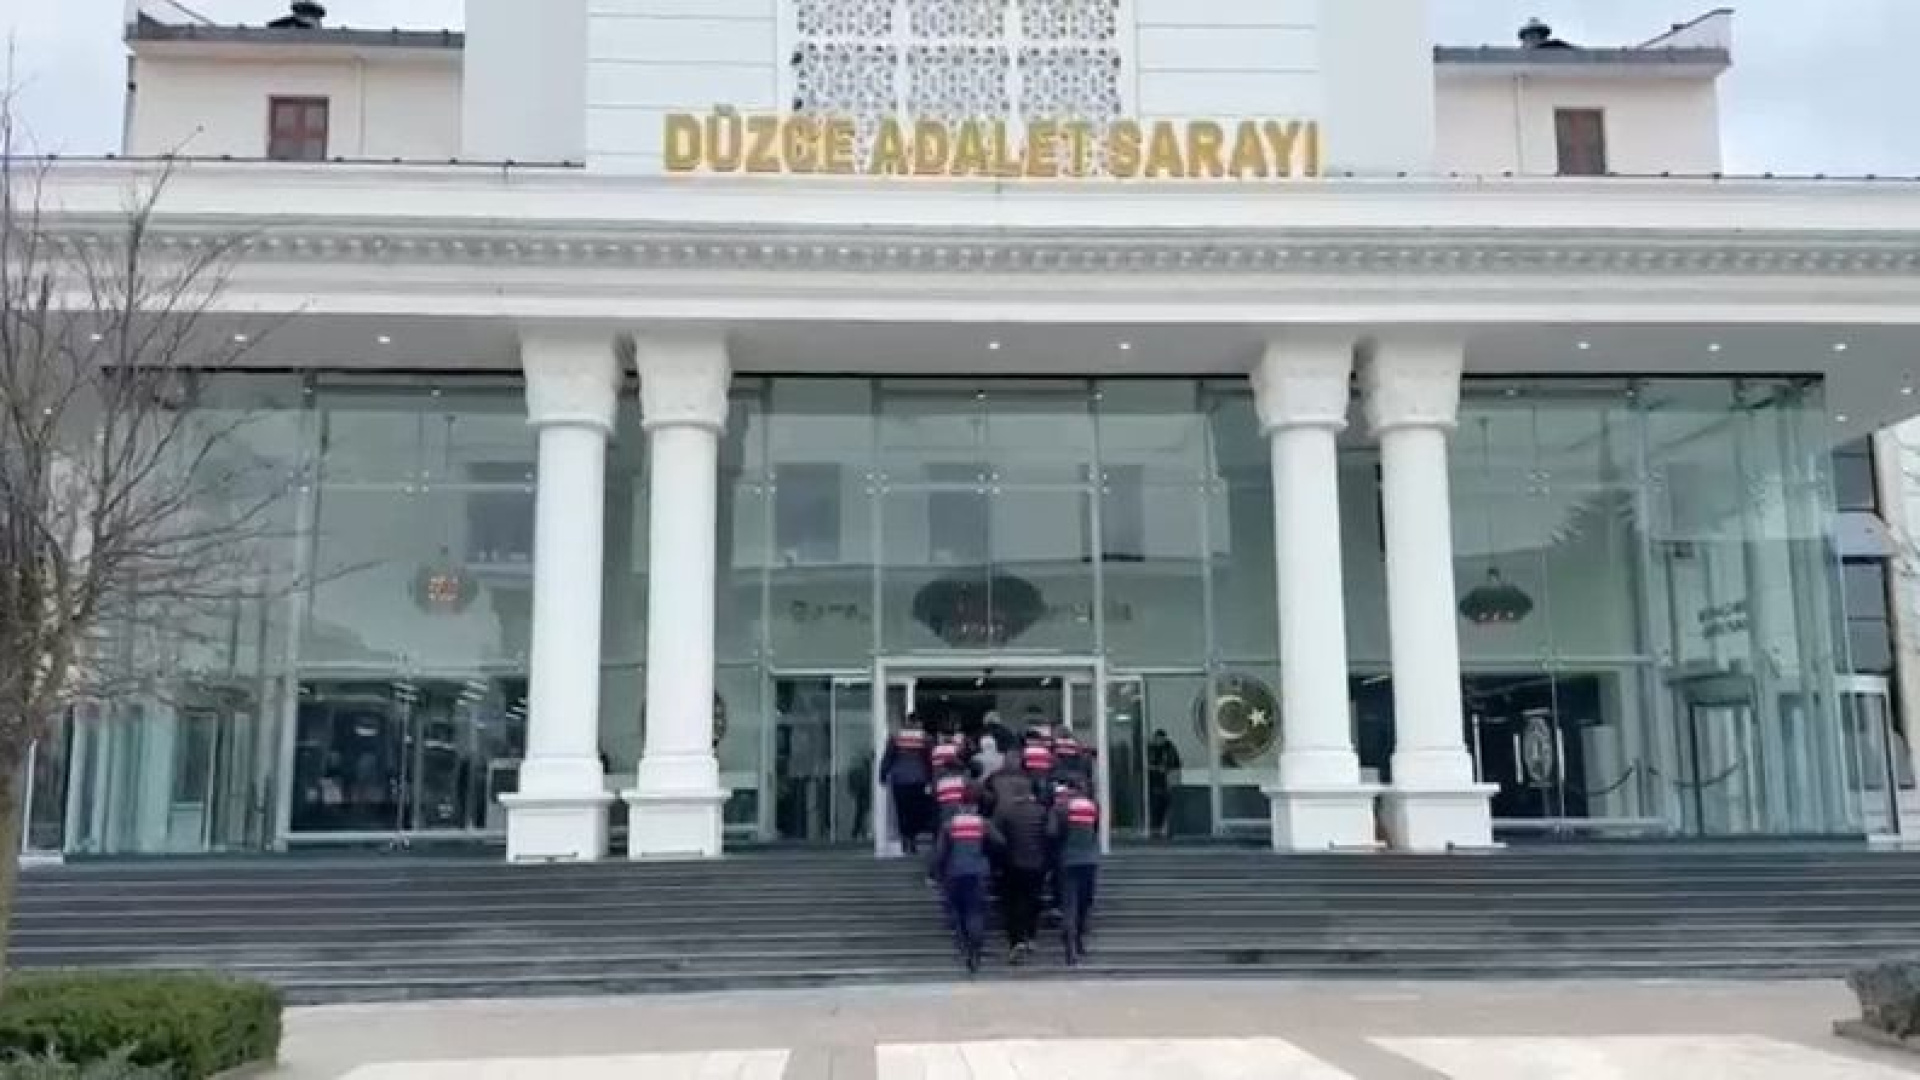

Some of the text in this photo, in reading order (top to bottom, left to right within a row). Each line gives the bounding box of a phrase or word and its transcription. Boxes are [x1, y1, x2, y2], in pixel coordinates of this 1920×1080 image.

[664, 104, 1318, 178] DÜZGE ADALET SARAYI
